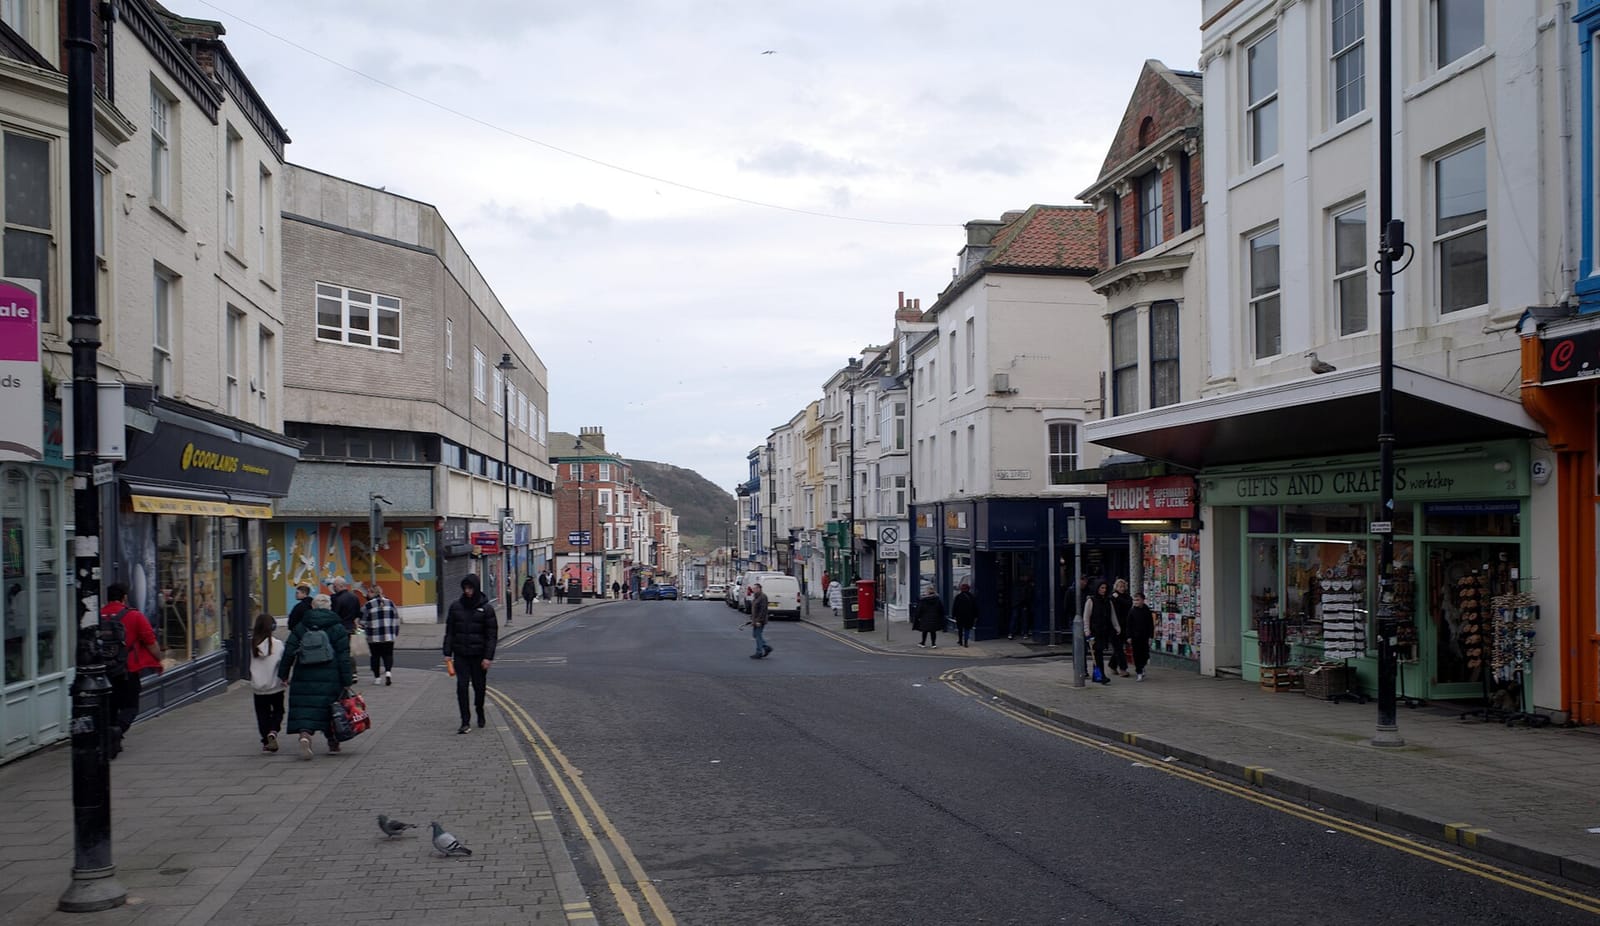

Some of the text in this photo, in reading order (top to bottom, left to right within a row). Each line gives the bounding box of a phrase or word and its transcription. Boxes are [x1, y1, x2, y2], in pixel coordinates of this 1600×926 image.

[192, 449, 239, 473] COOPLANDS
[1237, 466, 1454, 498] GIFTS AND CRAFS workshop
[1108, 487, 1151, 510] EUROPE
[1155, 498, 1165, 507] OFF
